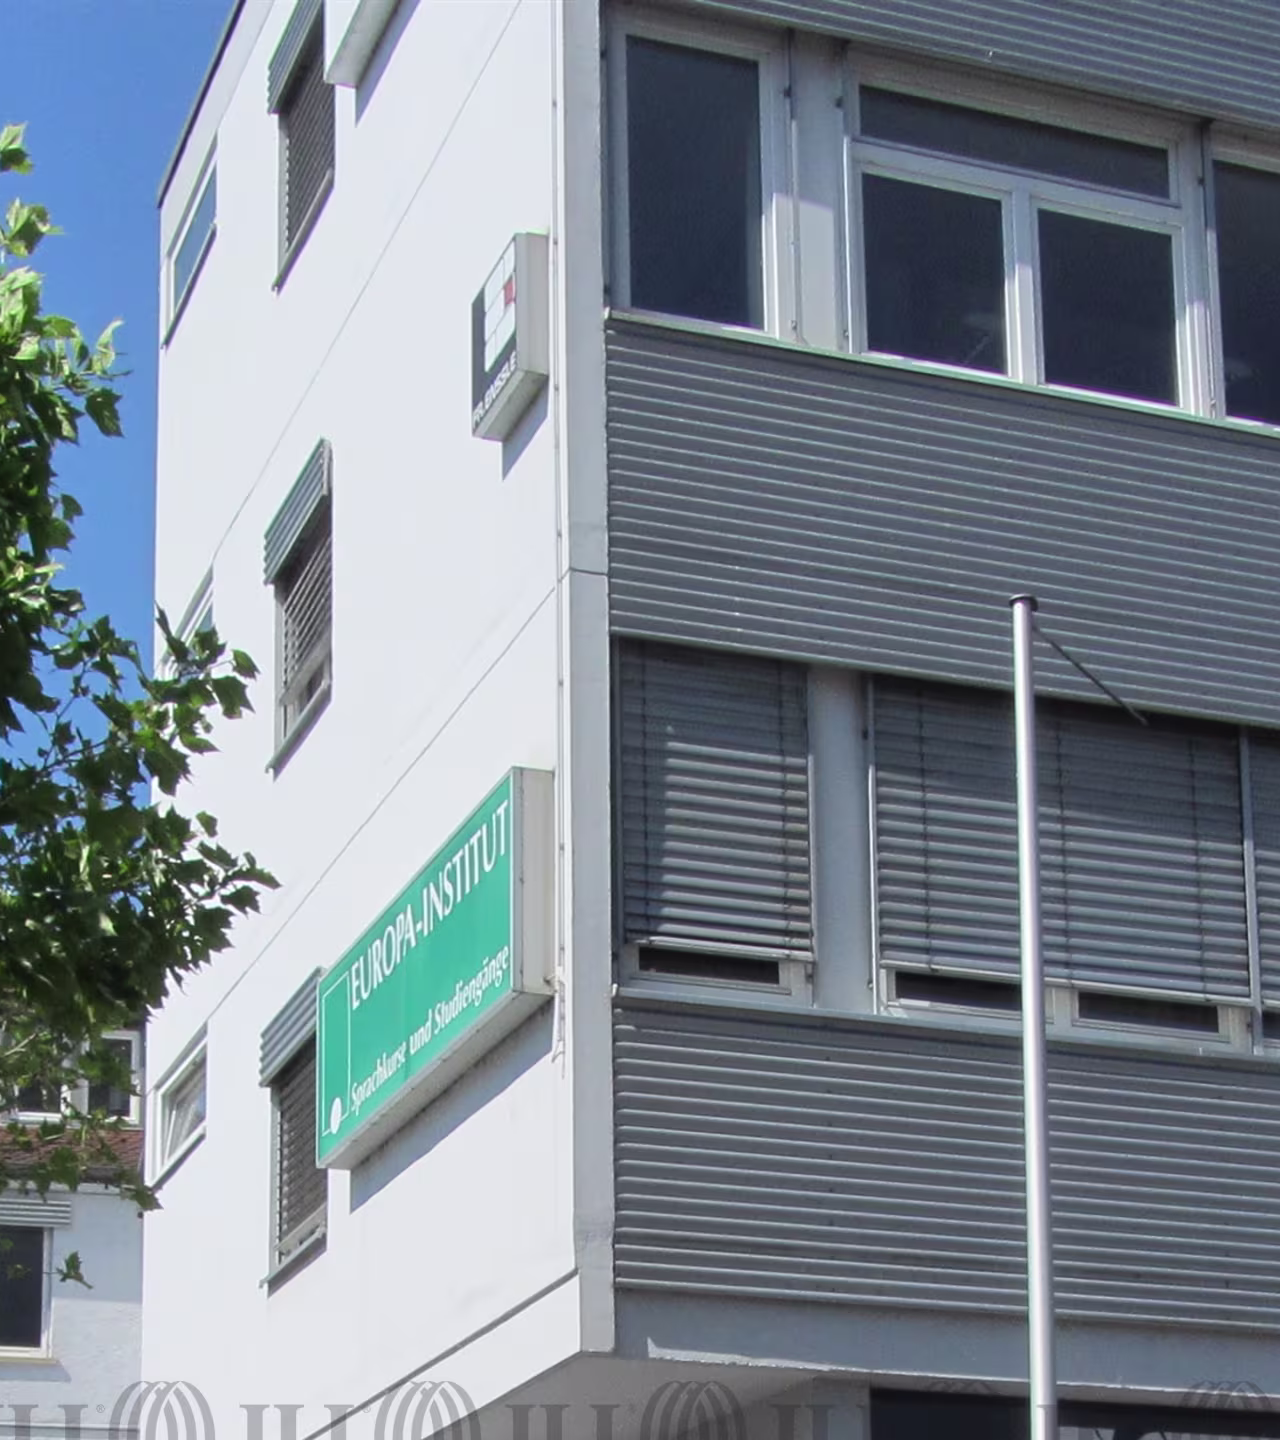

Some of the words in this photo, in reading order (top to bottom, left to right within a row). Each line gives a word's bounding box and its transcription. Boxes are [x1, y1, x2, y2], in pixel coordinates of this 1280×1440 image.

[350, 801, 508, 1010] EUROPA-INSTITUT
[351, 1038, 407, 1116] Sprachkurse
[409, 1012, 432, 1055] und
[434, 945, 509, 1034] Studiengänge
